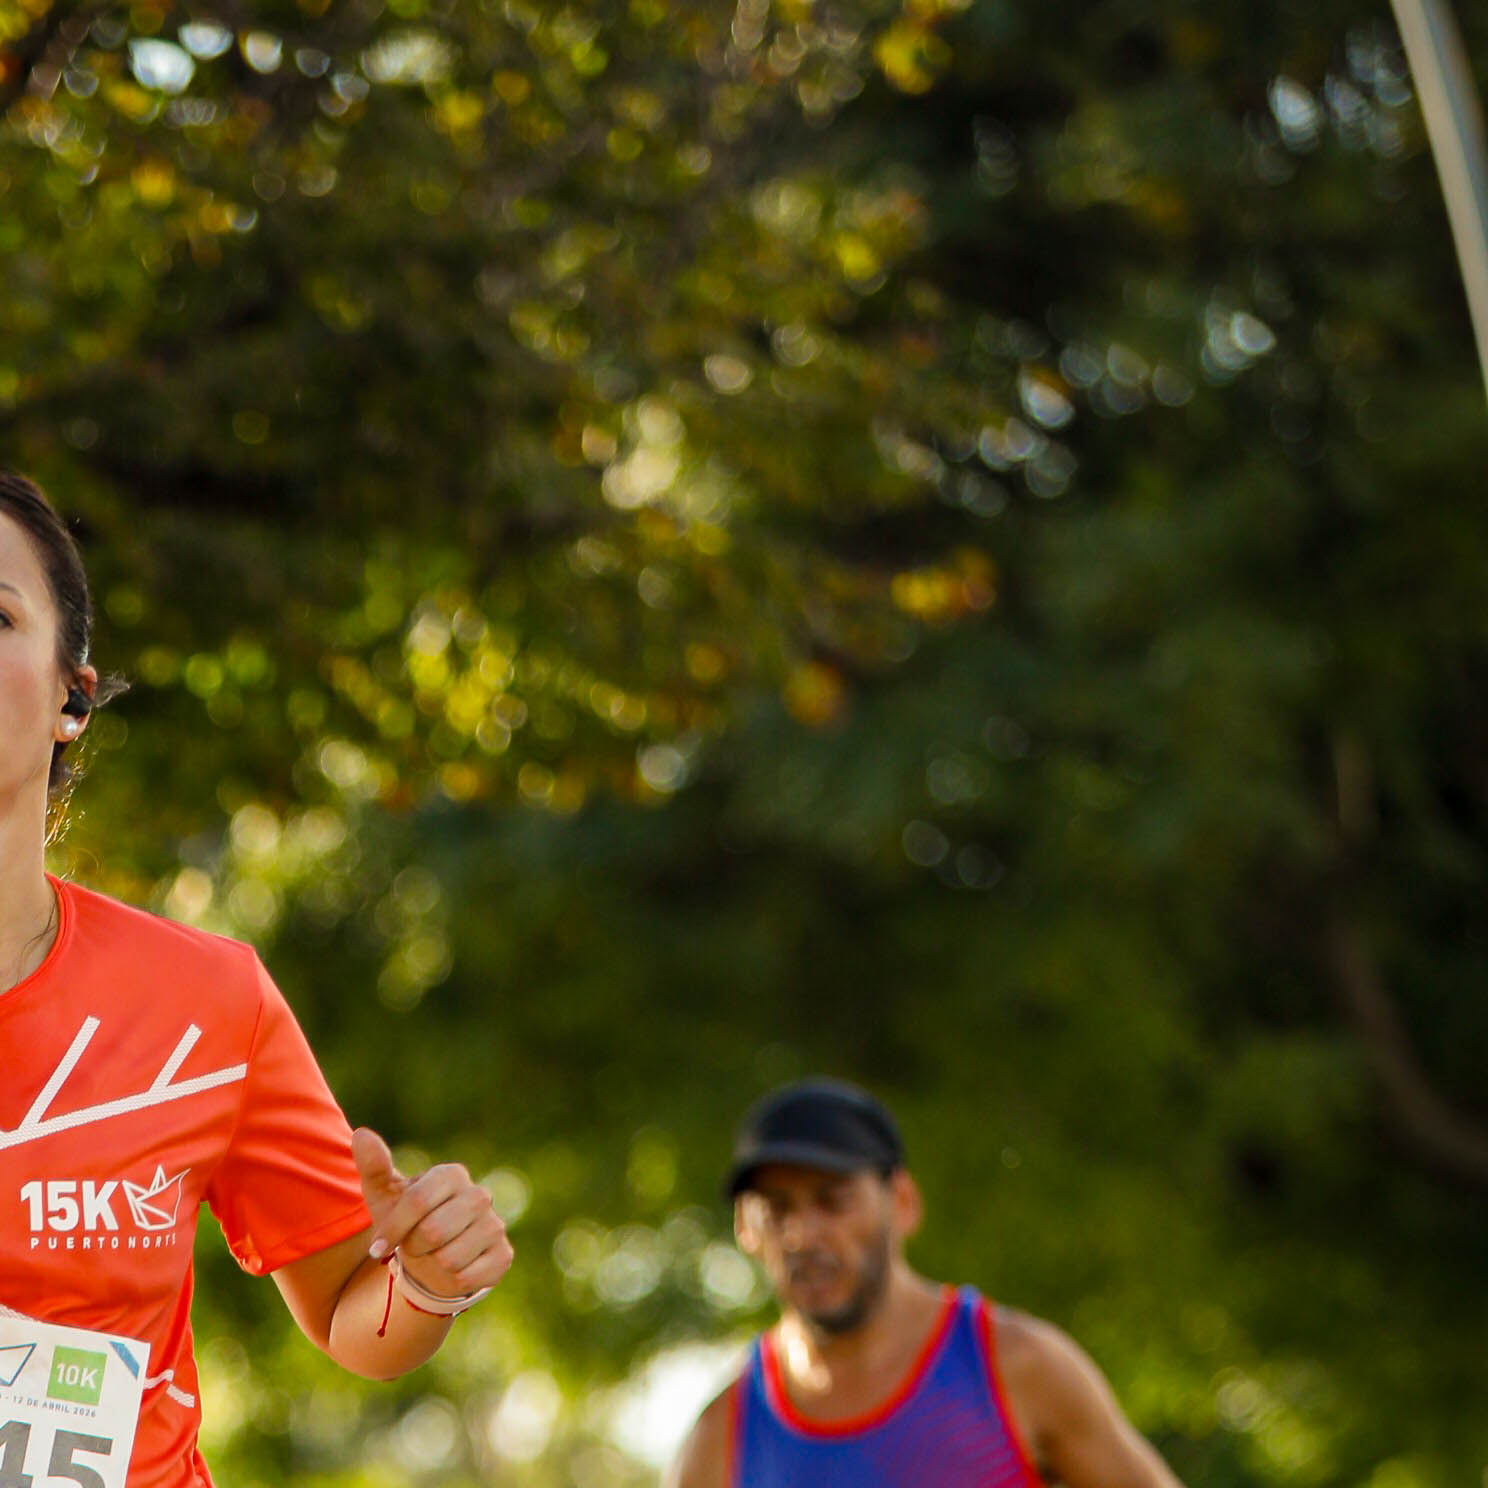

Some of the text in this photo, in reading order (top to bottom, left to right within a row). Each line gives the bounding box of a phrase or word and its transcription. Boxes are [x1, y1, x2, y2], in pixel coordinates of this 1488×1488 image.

[20, 1180, 120, 1232] 15K
[30, 1236, 119, 1250] PUERTO
[56, 1362, 99, 1390] 10K
[26, 1398, 39, 1408] DE
[42, 1400, 70, 1413] ABRIL
[73, 1406, 97, 1418] 2026
